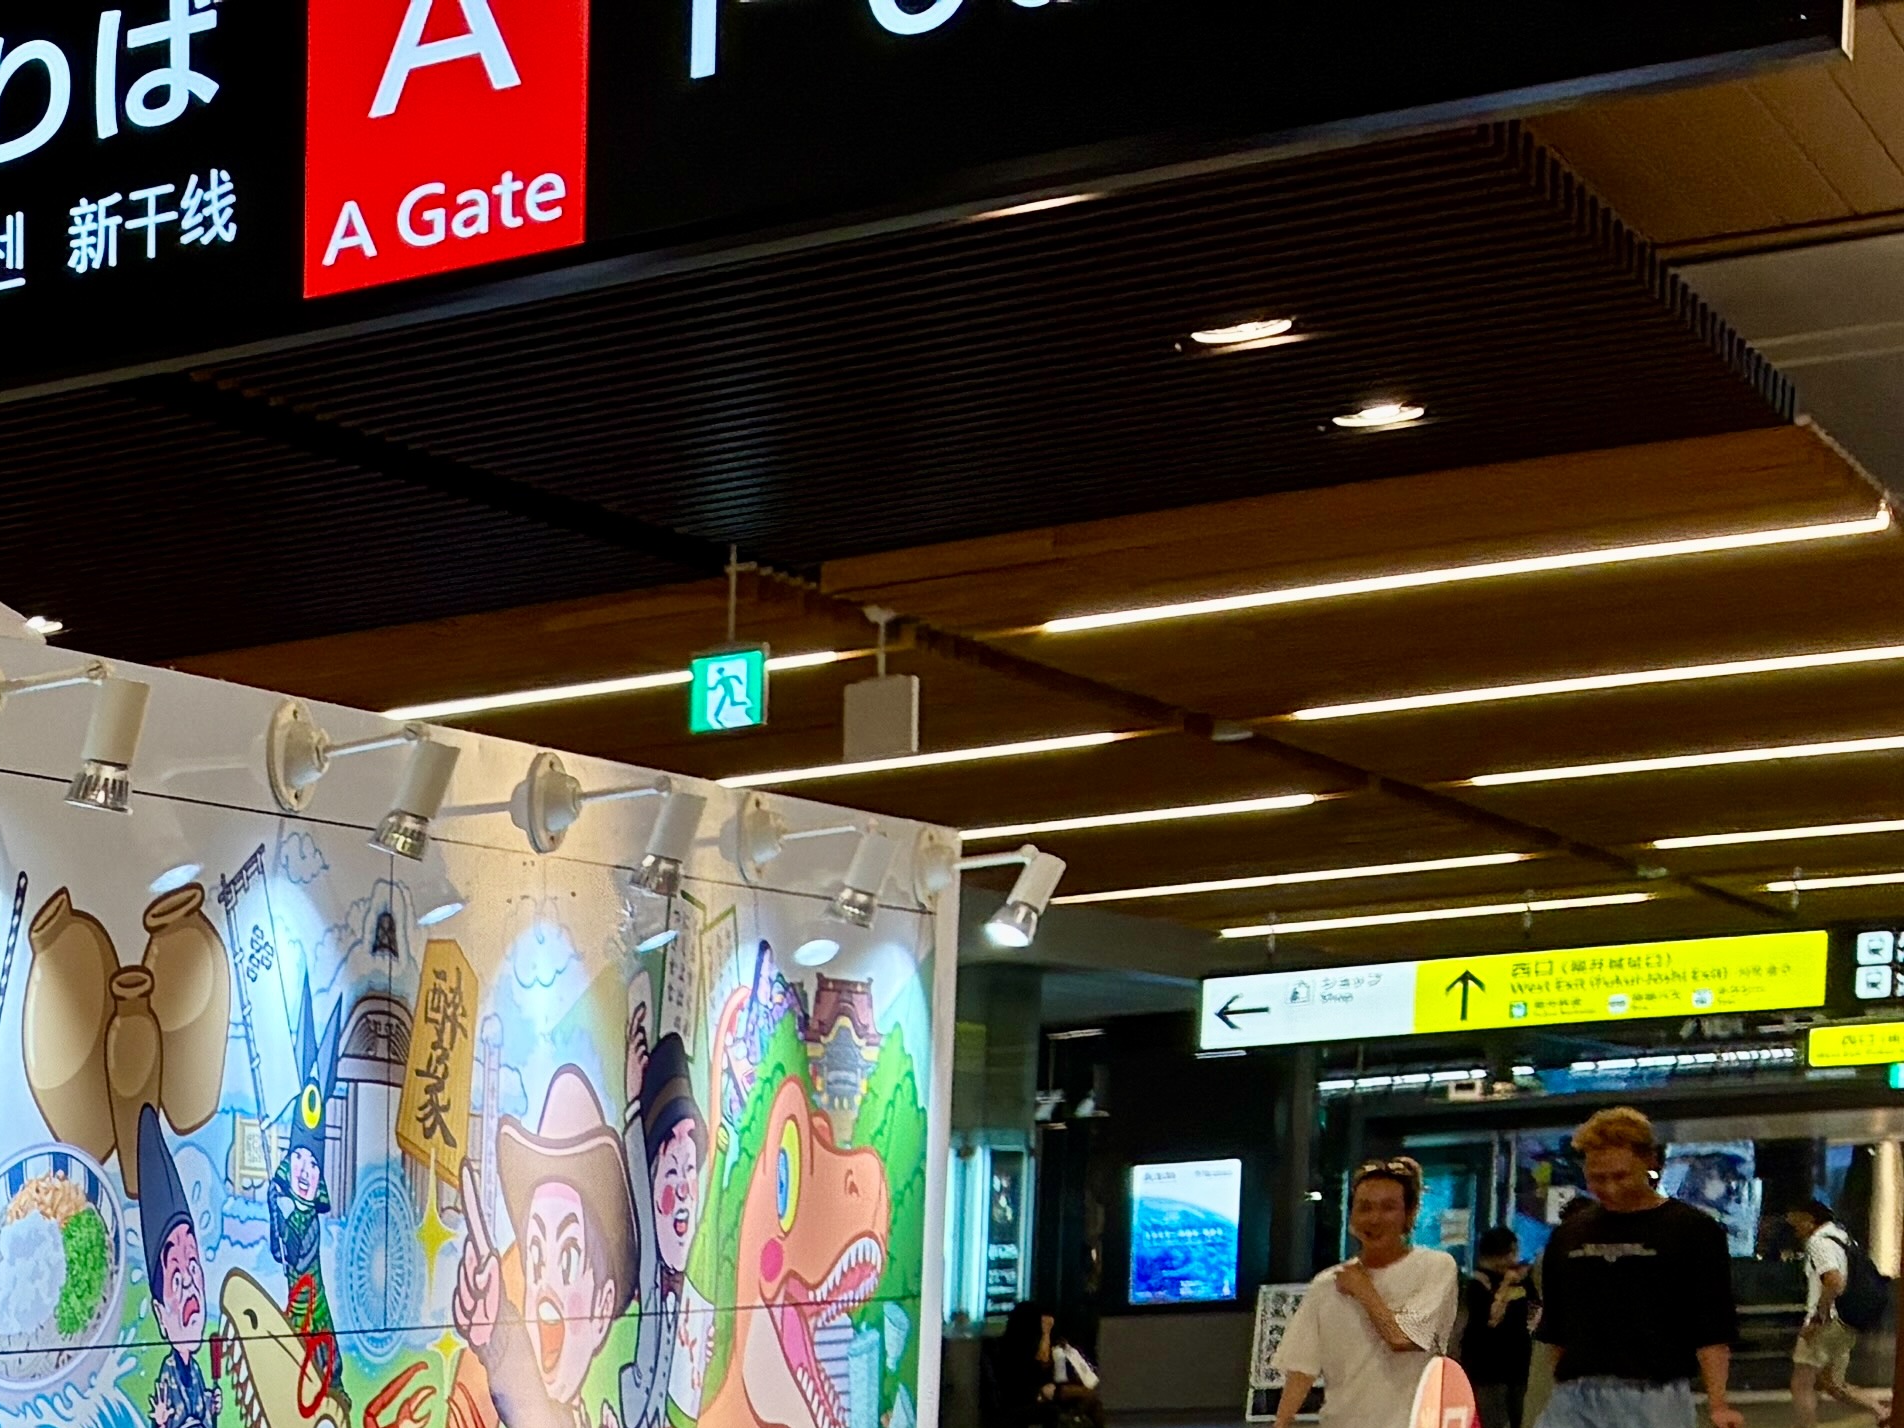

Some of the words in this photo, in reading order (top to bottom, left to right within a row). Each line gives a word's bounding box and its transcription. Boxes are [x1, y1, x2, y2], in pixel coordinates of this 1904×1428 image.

[367, 0, 522, 118] A
[67, 167, 237, 274] 新干线
[321, 200, 378, 267] A
[397, 171, 566, 248] Gate
